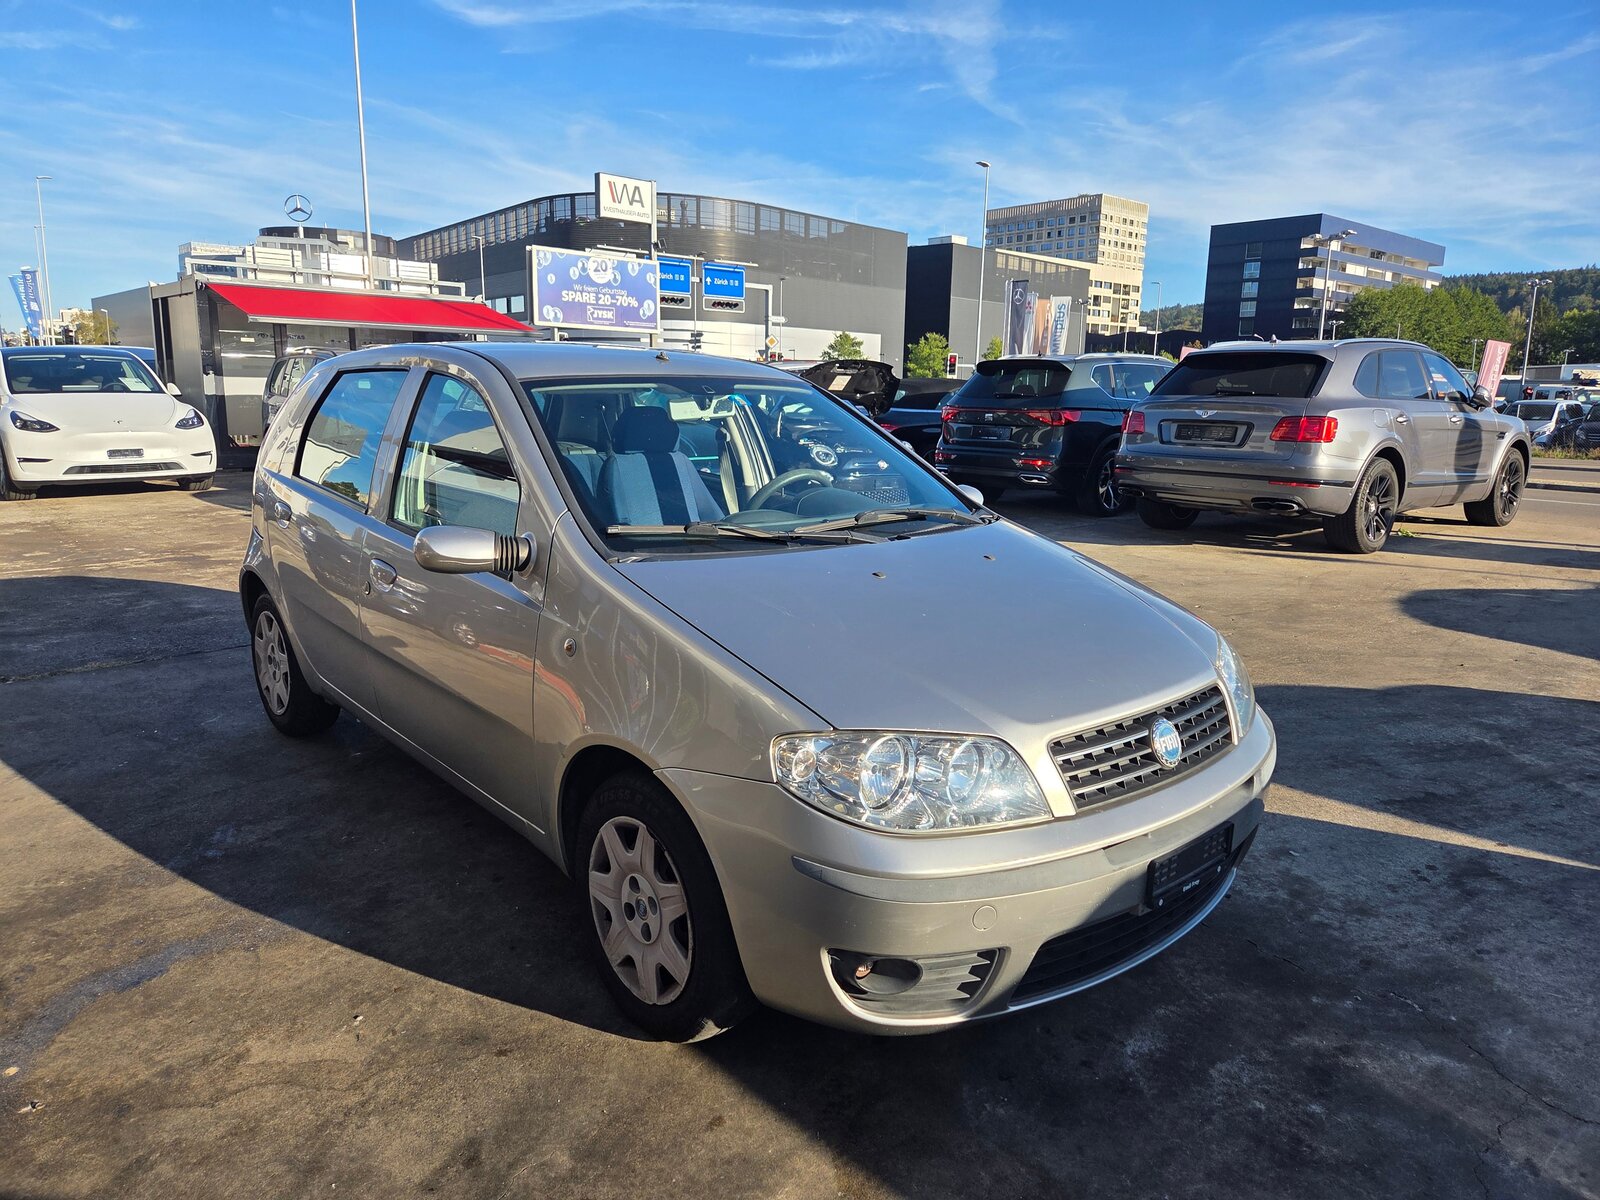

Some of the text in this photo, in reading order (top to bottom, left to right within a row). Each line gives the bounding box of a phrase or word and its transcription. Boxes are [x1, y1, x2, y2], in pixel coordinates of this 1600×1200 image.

[637, 211, 650, 219] AUTO
[592, 259, 609, 273] 20
[561, 289, 597, 304] SPARE
[599, 286, 628, 297] Geburtstag
[593, 309, 614, 319] JYSK
[1160, 733, 1178, 752] FIAT
